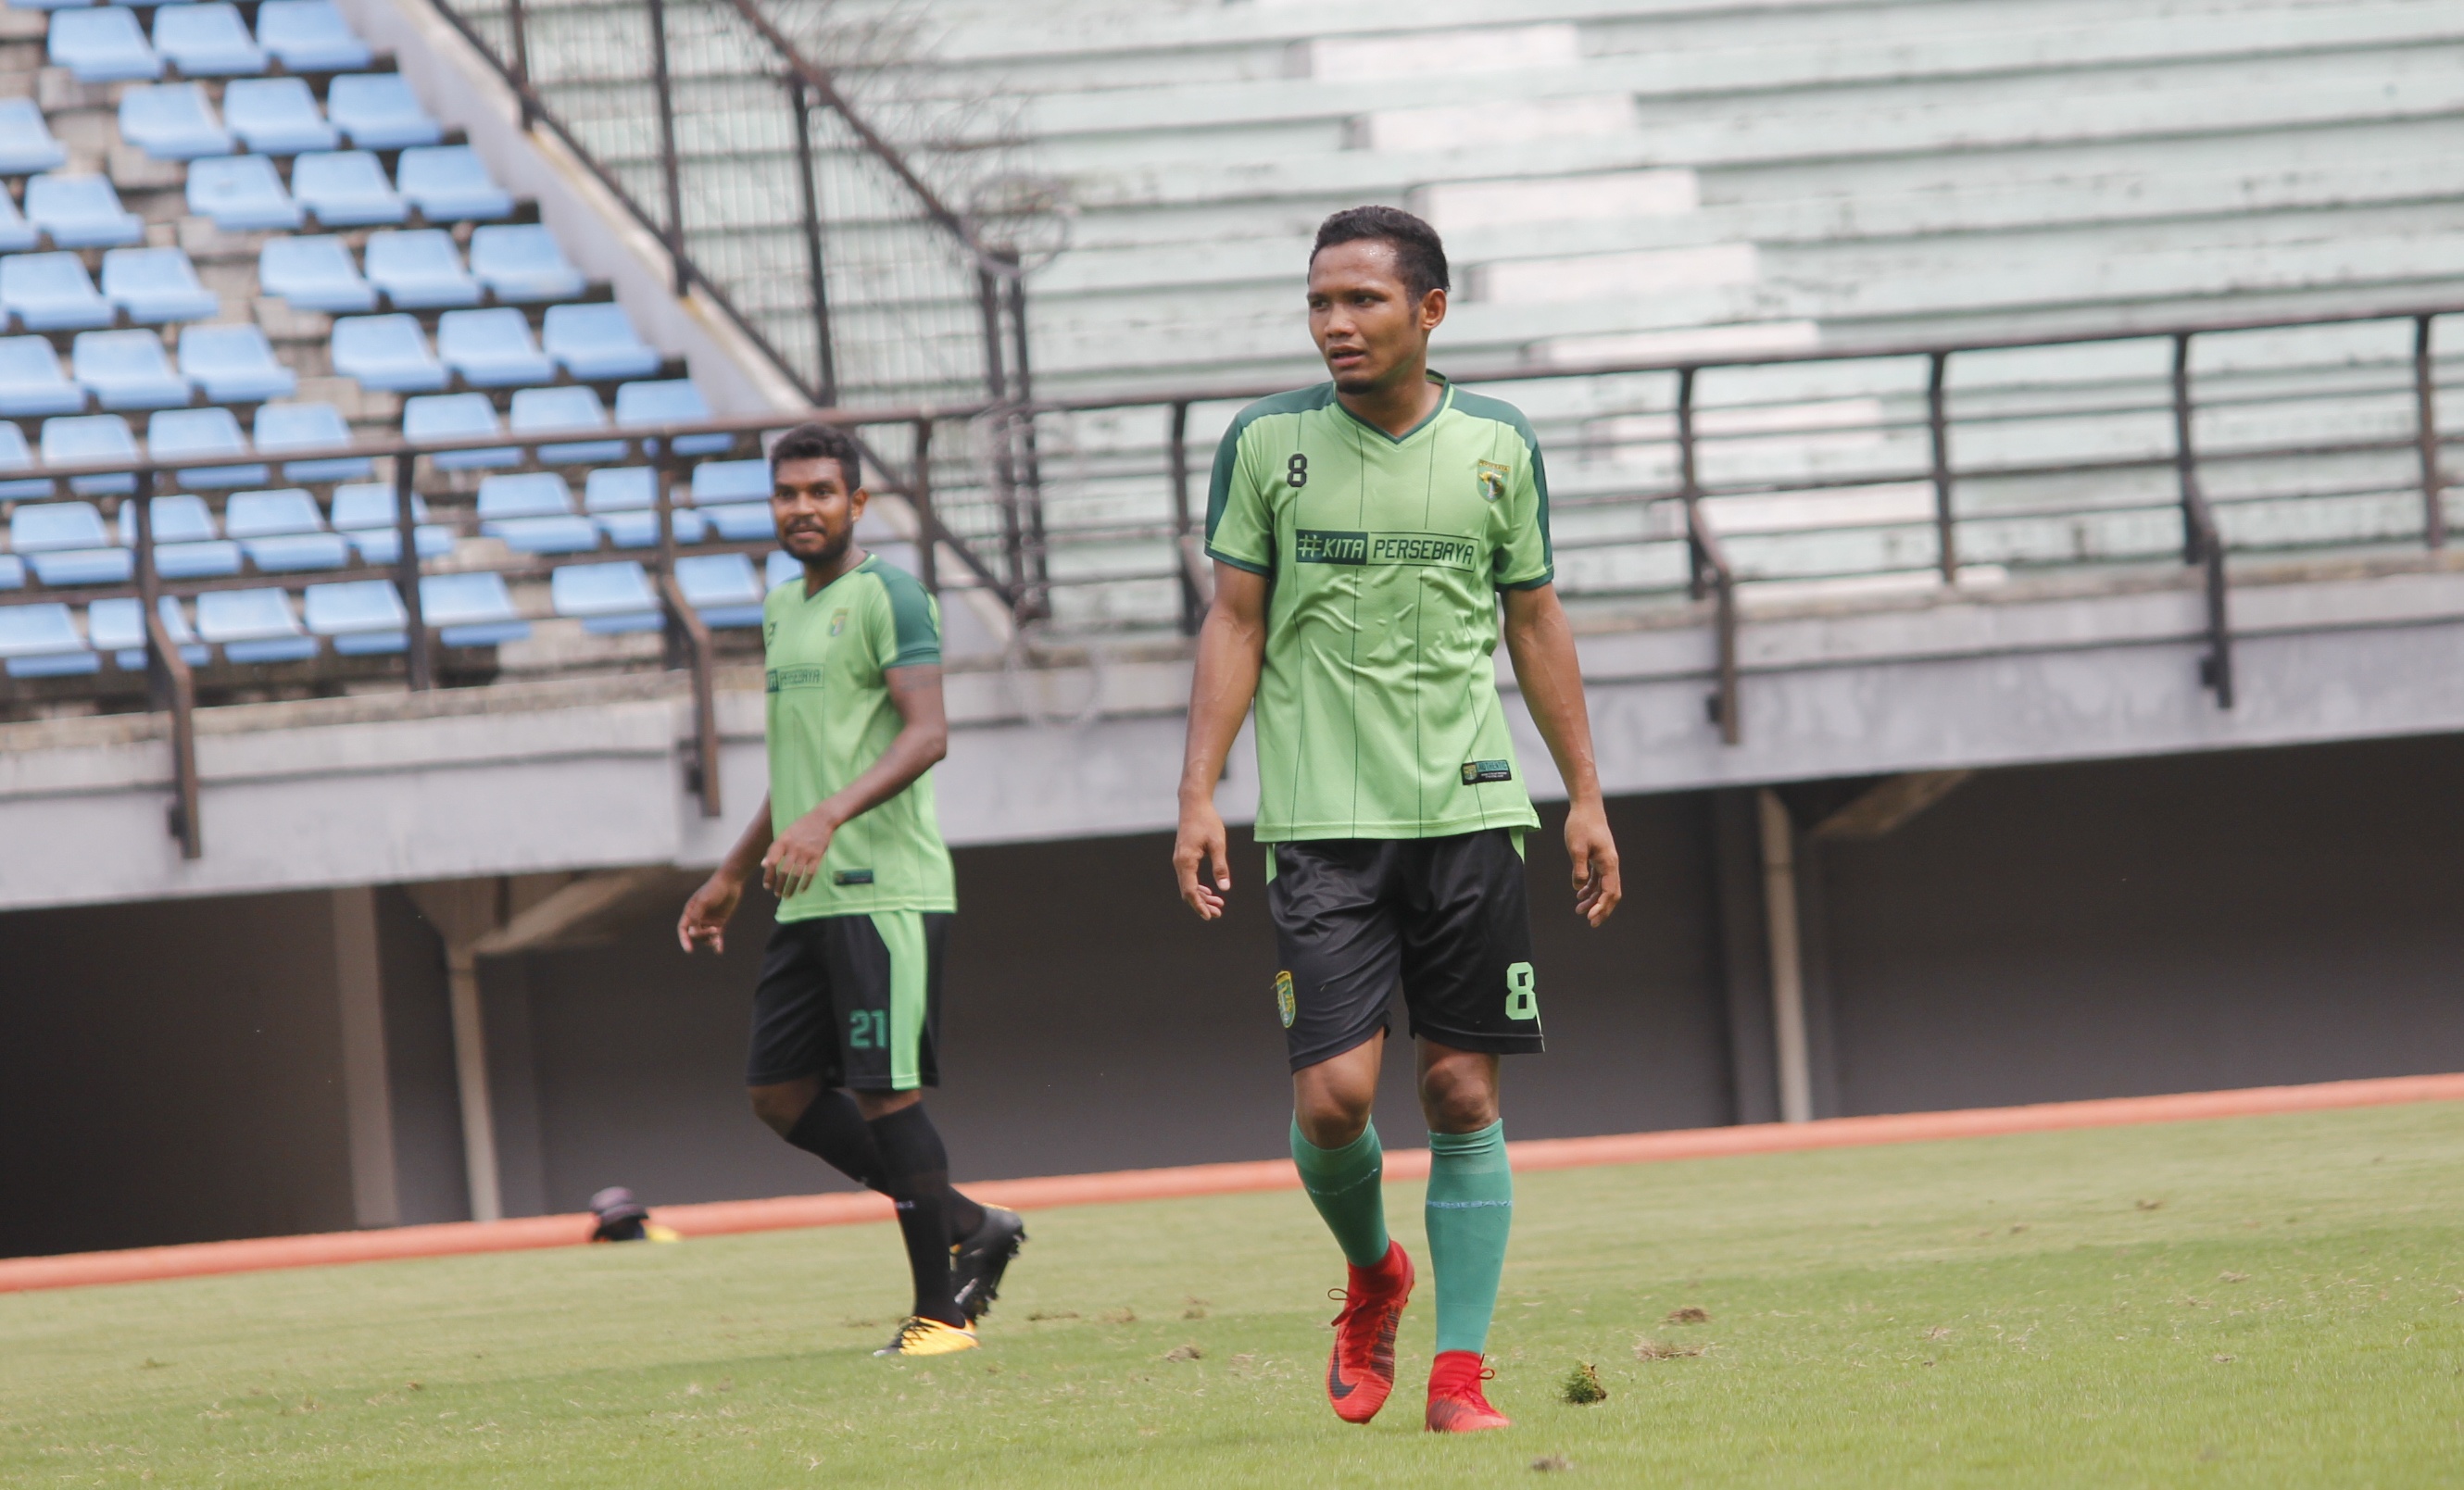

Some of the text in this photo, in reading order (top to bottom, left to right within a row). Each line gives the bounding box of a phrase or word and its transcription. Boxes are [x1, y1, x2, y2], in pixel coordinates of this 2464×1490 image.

[1287, 453, 1308, 487] 8
[1298, 533, 1475, 565] #KITA PERSEBAYA
[1505, 961, 1537, 1020] 8
[850, 1009, 886, 1047] 21
